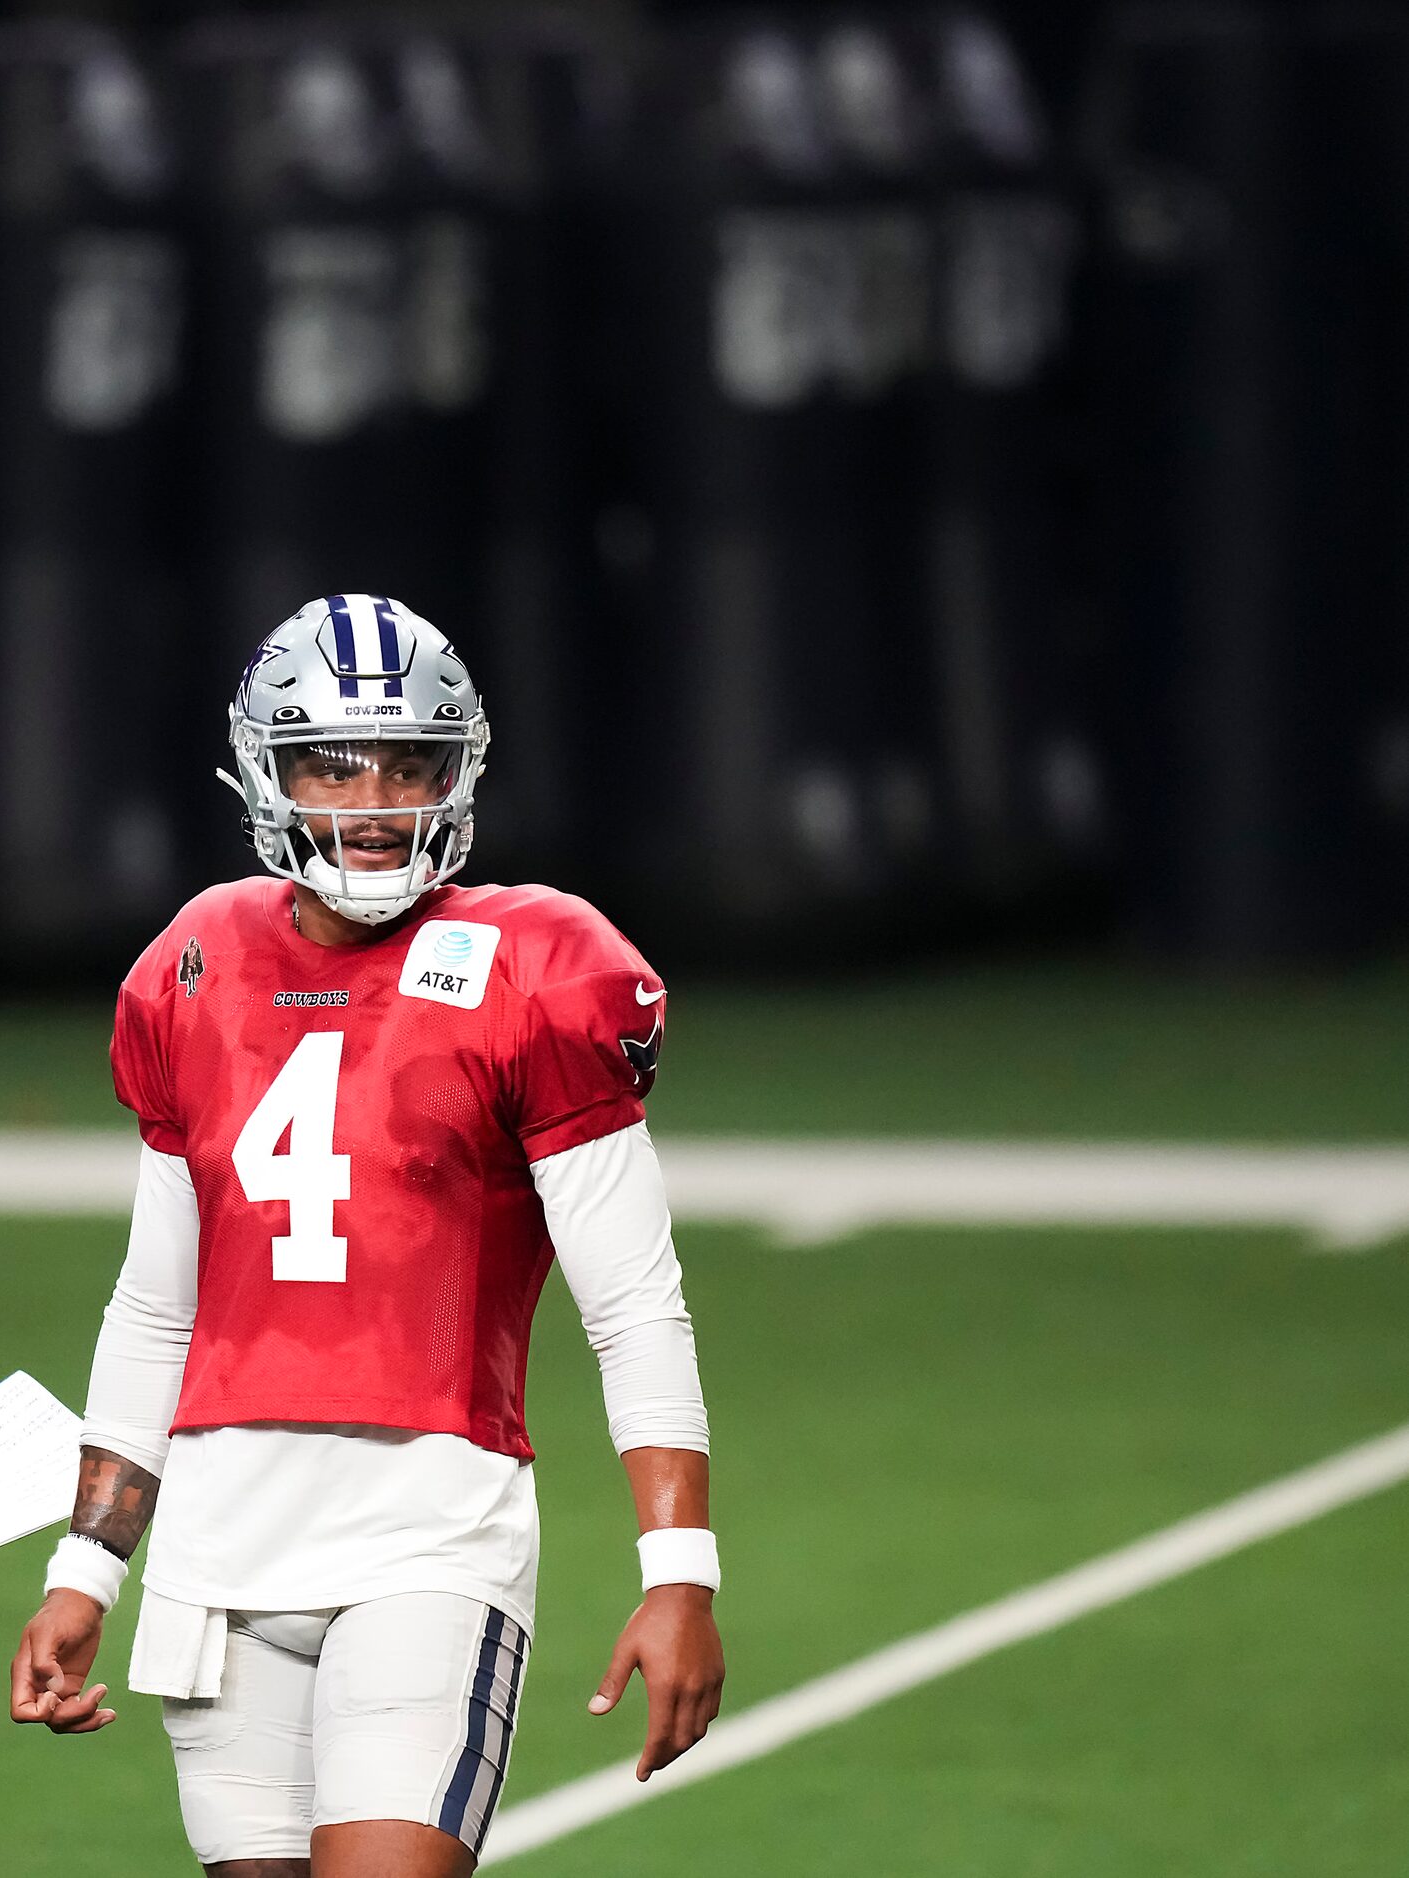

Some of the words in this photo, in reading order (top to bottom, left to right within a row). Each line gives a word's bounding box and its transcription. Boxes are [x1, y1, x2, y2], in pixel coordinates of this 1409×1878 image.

[345, 705, 402, 715] COWBOYS
[417, 971, 469, 994] AT&T
[273, 990, 350, 1007] COWBOYS
[231, 1031, 351, 1282] 4
